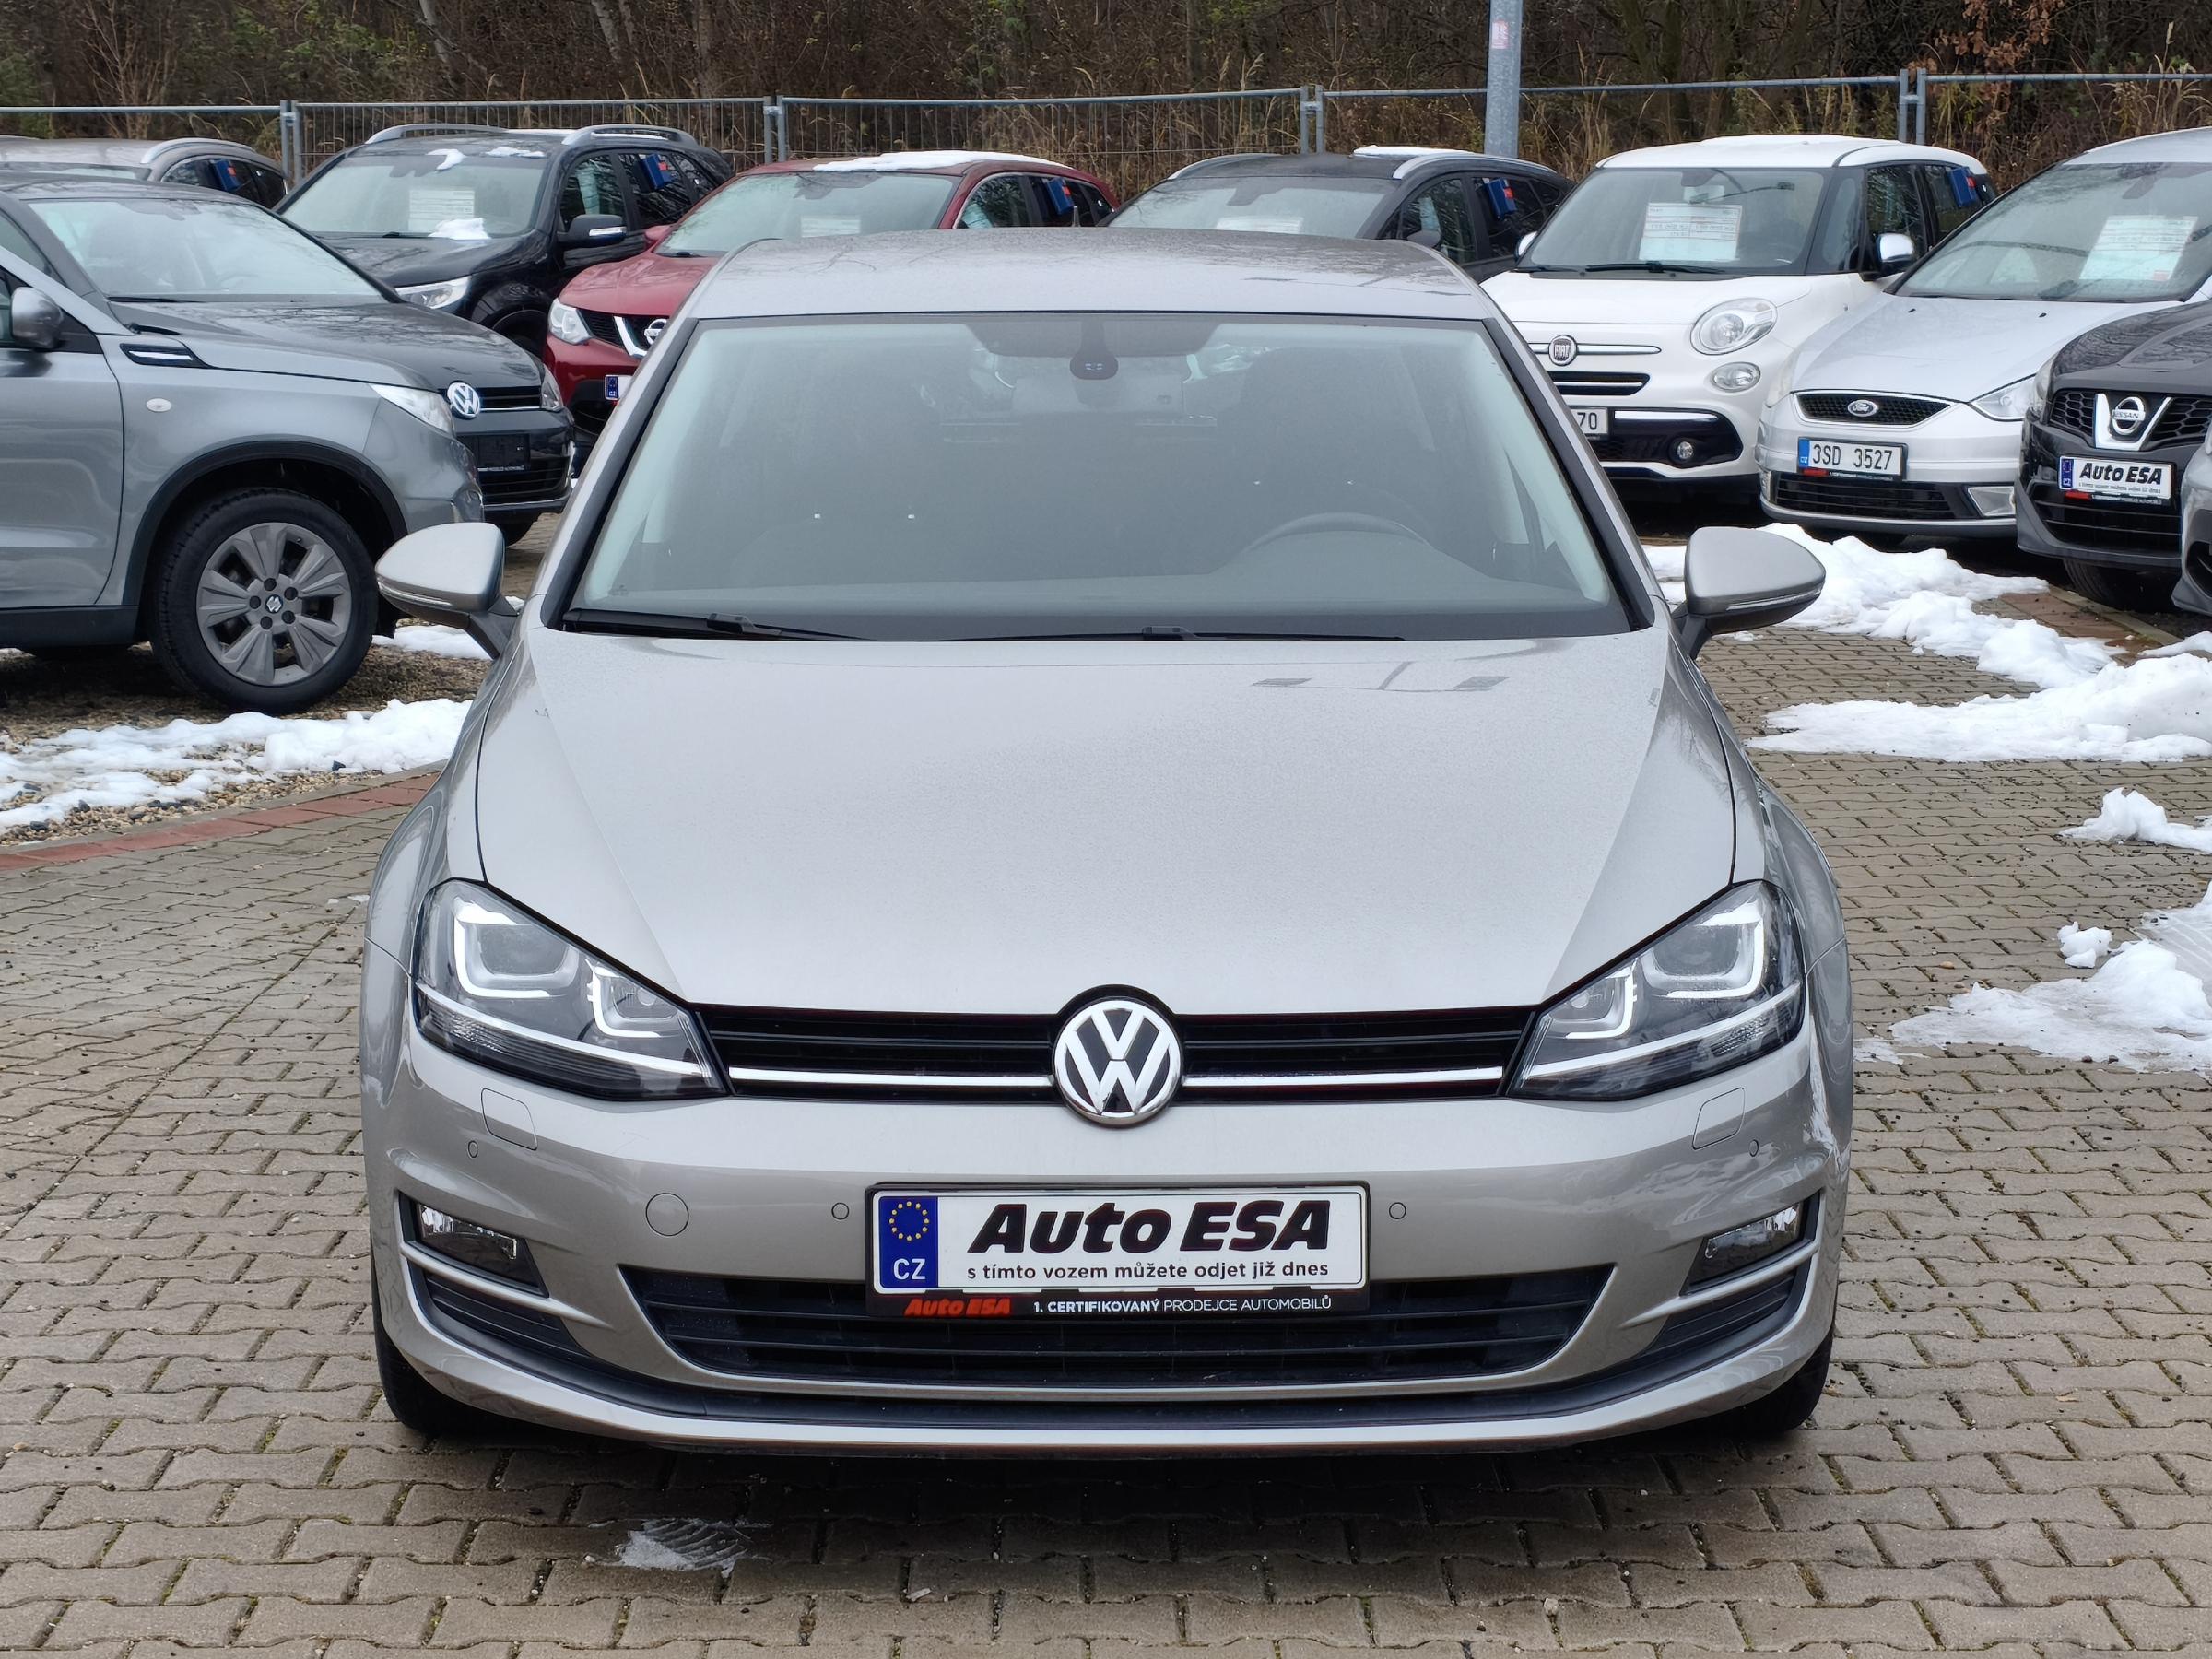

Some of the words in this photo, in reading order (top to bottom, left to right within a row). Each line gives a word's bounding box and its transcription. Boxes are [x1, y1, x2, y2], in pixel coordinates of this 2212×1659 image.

[1577, 411, 1598, 430] 70
[1812, 443, 1841, 466] 3SD
[1853, 448, 1893, 470] 3527
[2078, 462, 2124, 482] Auto
[2125, 465, 2163, 485] ESA
[967, 1202, 1171, 1254] Auto
[1179, 1200, 1331, 1252] ESA
[893, 1258, 926, 1280] CZ
[967, 1266, 976, 1279] s
[982, 1264, 1037, 1279] tímto
[1042, 1266, 1108, 1279] vozem
[1114, 1261, 1188, 1279] můžete
[1194, 1262, 1246, 1280] odjet
[1251, 1261, 1276, 1280] již
[1281, 1261, 1329, 1277] dnes
[903, 1298, 966, 1317] Auto
[965, 1298, 1011, 1316] ESA
[1033, 1301, 1043, 1313] 1.
[1047, 1298, 1160, 1313] CERTIFIKOVANÝ
[1163, 1299, 1238, 1312] PRODEJCE
[1241, 1294, 1332, 1312] AUTOMOBILŮ
